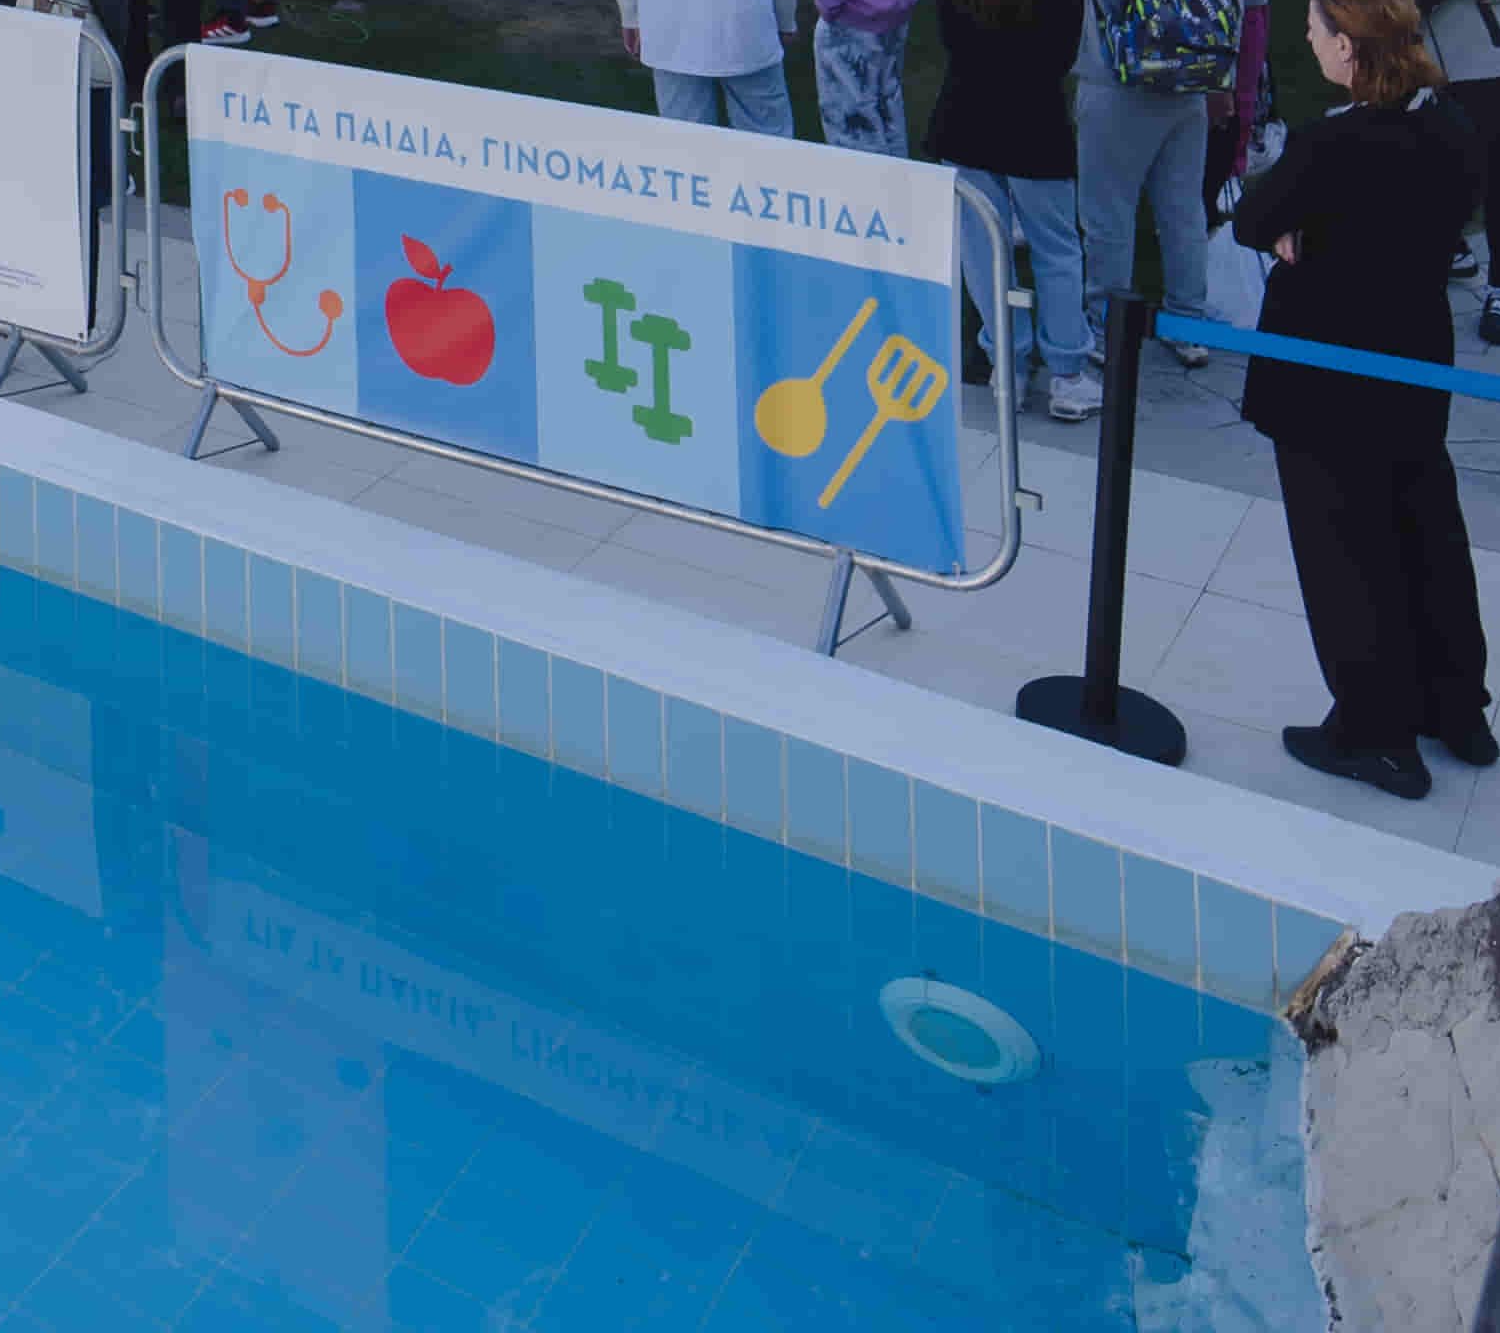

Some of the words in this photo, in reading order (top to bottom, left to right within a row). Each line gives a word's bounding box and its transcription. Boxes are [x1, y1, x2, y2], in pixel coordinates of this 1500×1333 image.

[223, 90, 272, 126] ΓΙΑ
[283, 101, 321, 136] ΤΑ
[335, 111, 468, 167] ΠΑΙΔΙΑ,
[482, 137, 713, 209] ΓΙΝΟΜΑΣΤΕ
[728, 182, 906, 246] ΑΣΠΙΔΑ.
